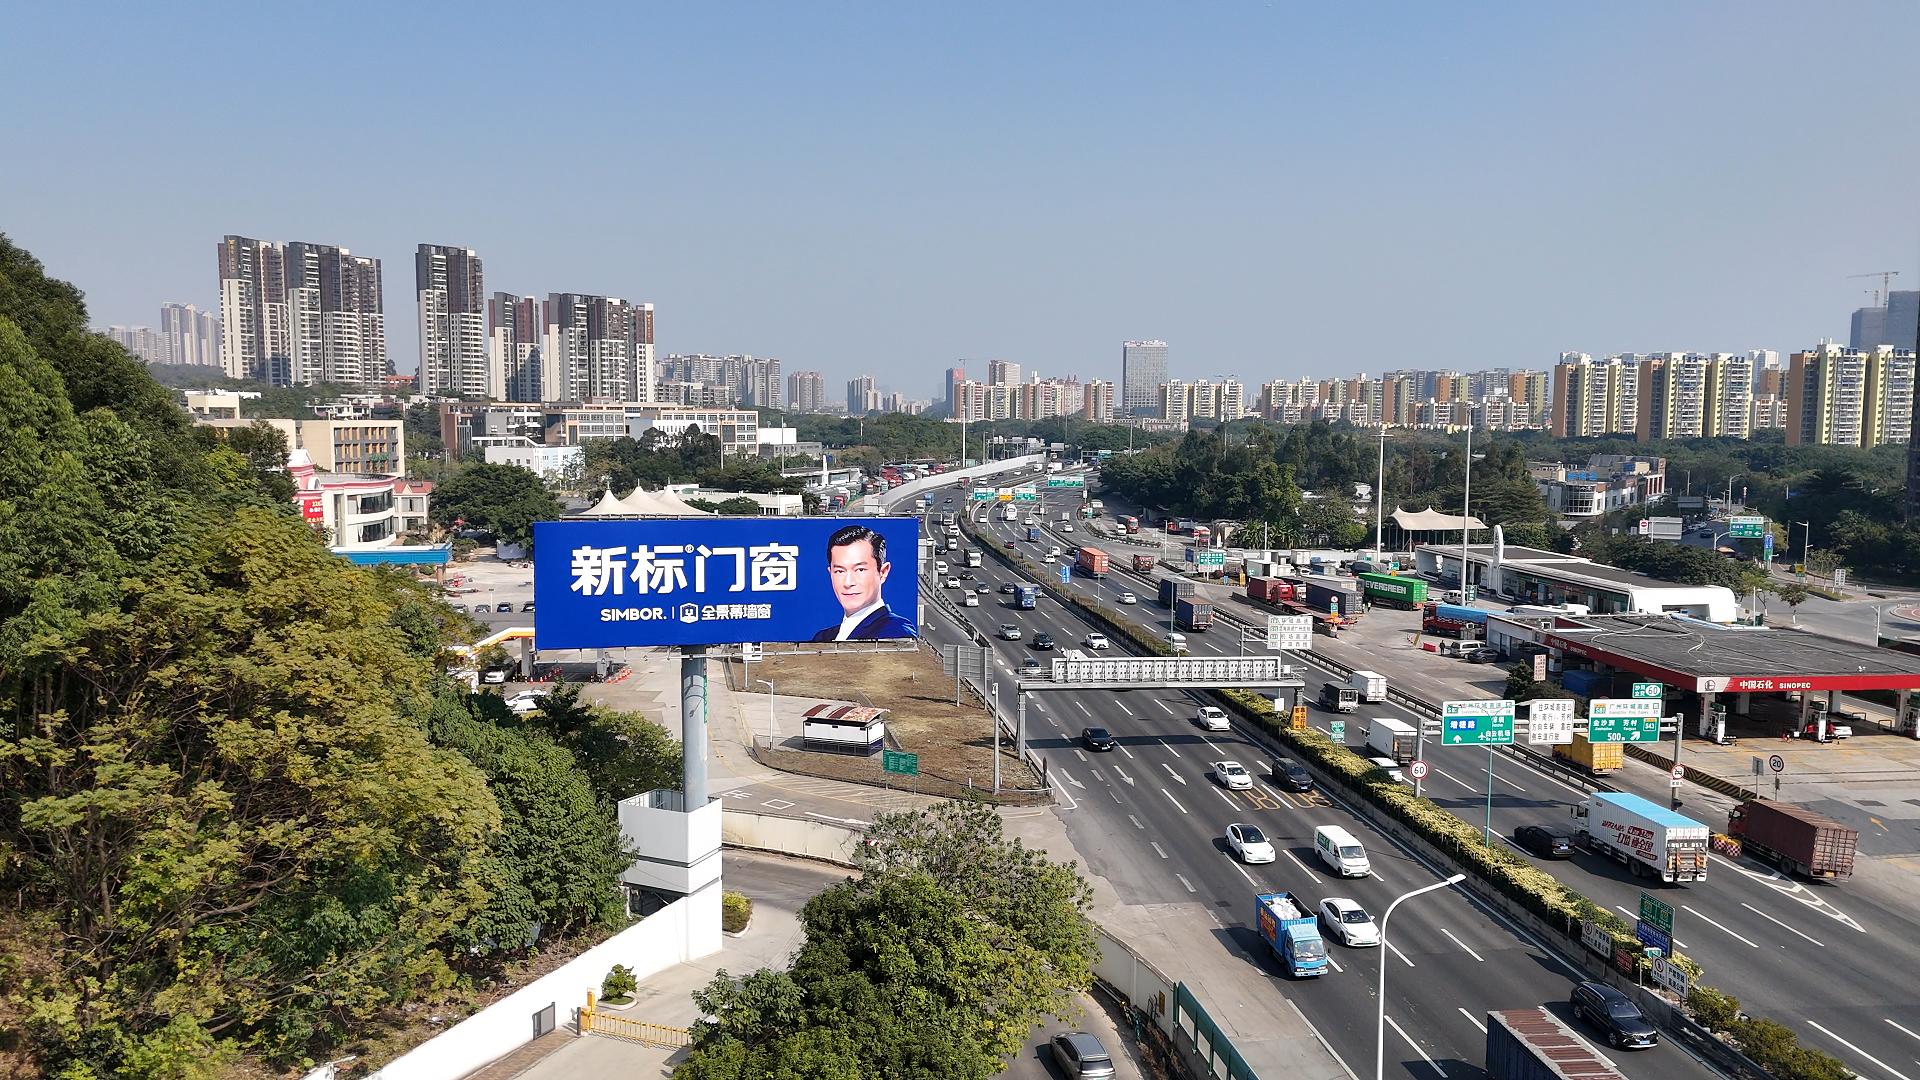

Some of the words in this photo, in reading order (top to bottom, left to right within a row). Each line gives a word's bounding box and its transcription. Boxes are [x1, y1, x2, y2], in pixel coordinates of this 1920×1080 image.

[1365, 580, 1407, 595] EVERGREEN
[701, 603, 772, 621] 全景幕墙窗
[1740, 680, 1774, 690] 中国石化
[1648, 686, 1658, 695] 60
[1772, 758, 1782, 768] 20
[1413, 765, 1425, 775] 60
